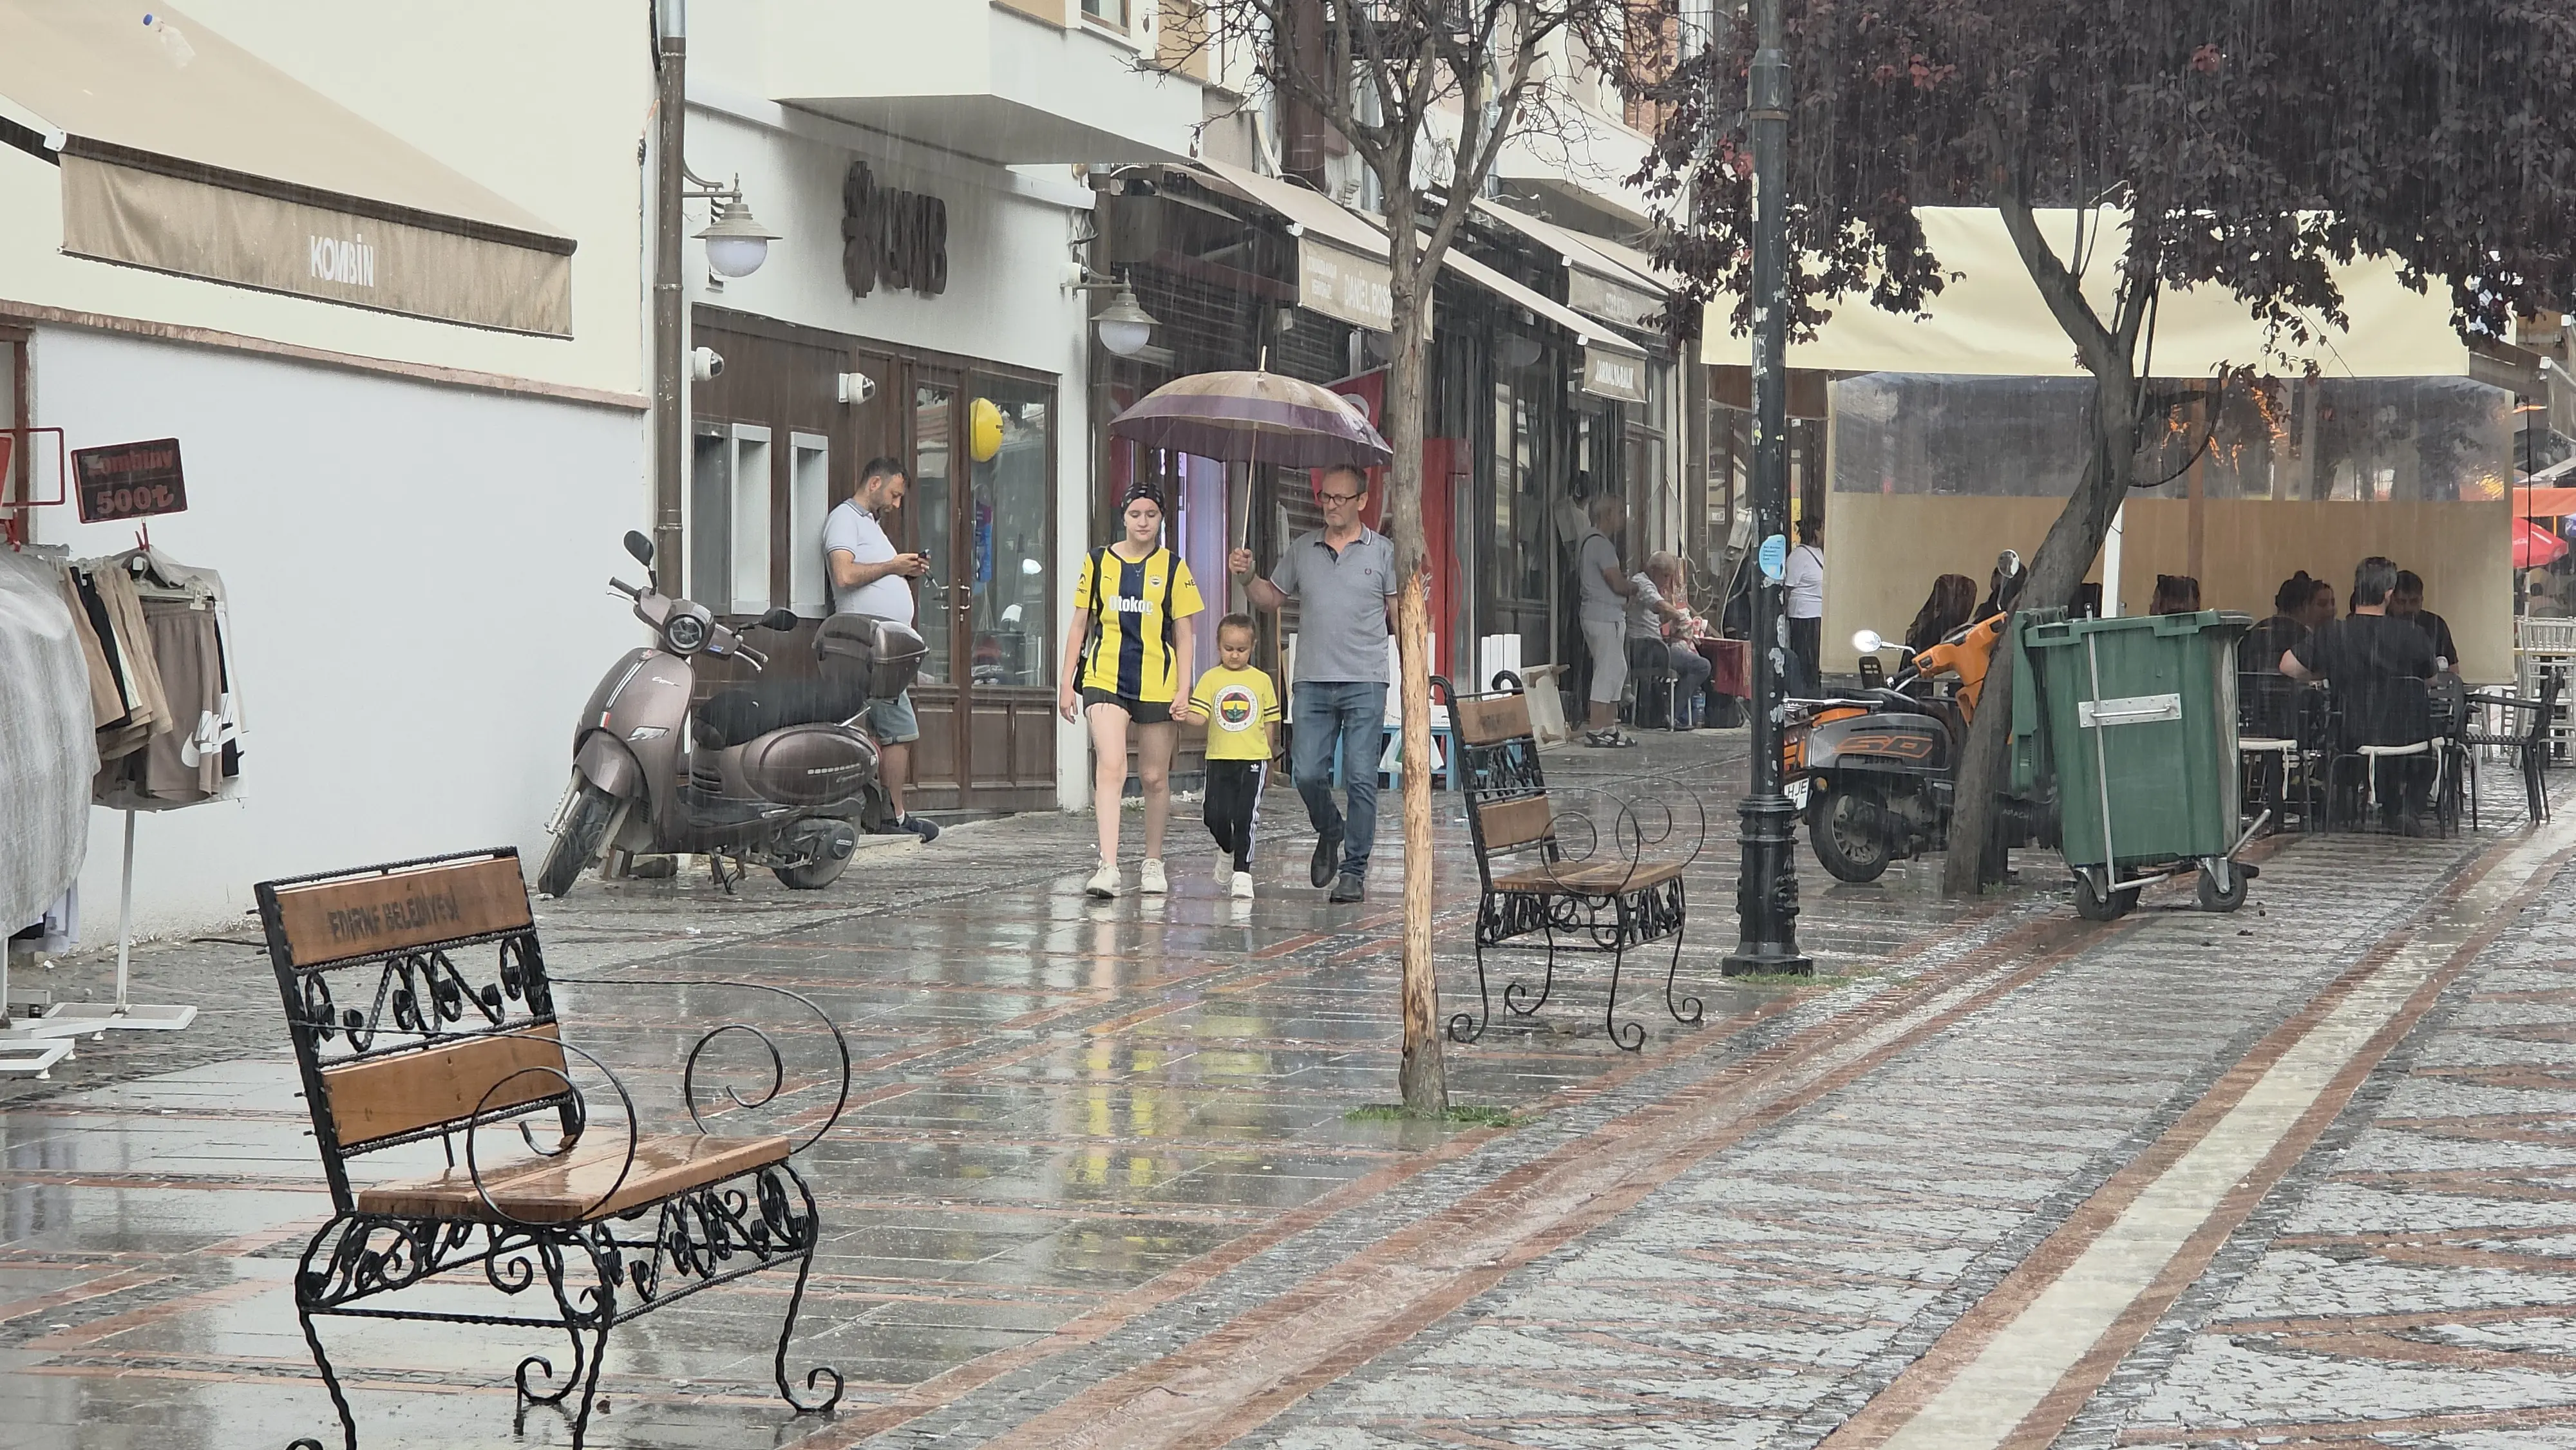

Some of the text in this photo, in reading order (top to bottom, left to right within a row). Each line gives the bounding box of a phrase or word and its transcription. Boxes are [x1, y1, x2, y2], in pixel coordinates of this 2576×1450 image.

[310, 233, 374, 288] KOMBİN
[1372, 283, 1393, 319] ROSS
[1108, 595, 1153, 615] Otokoç
